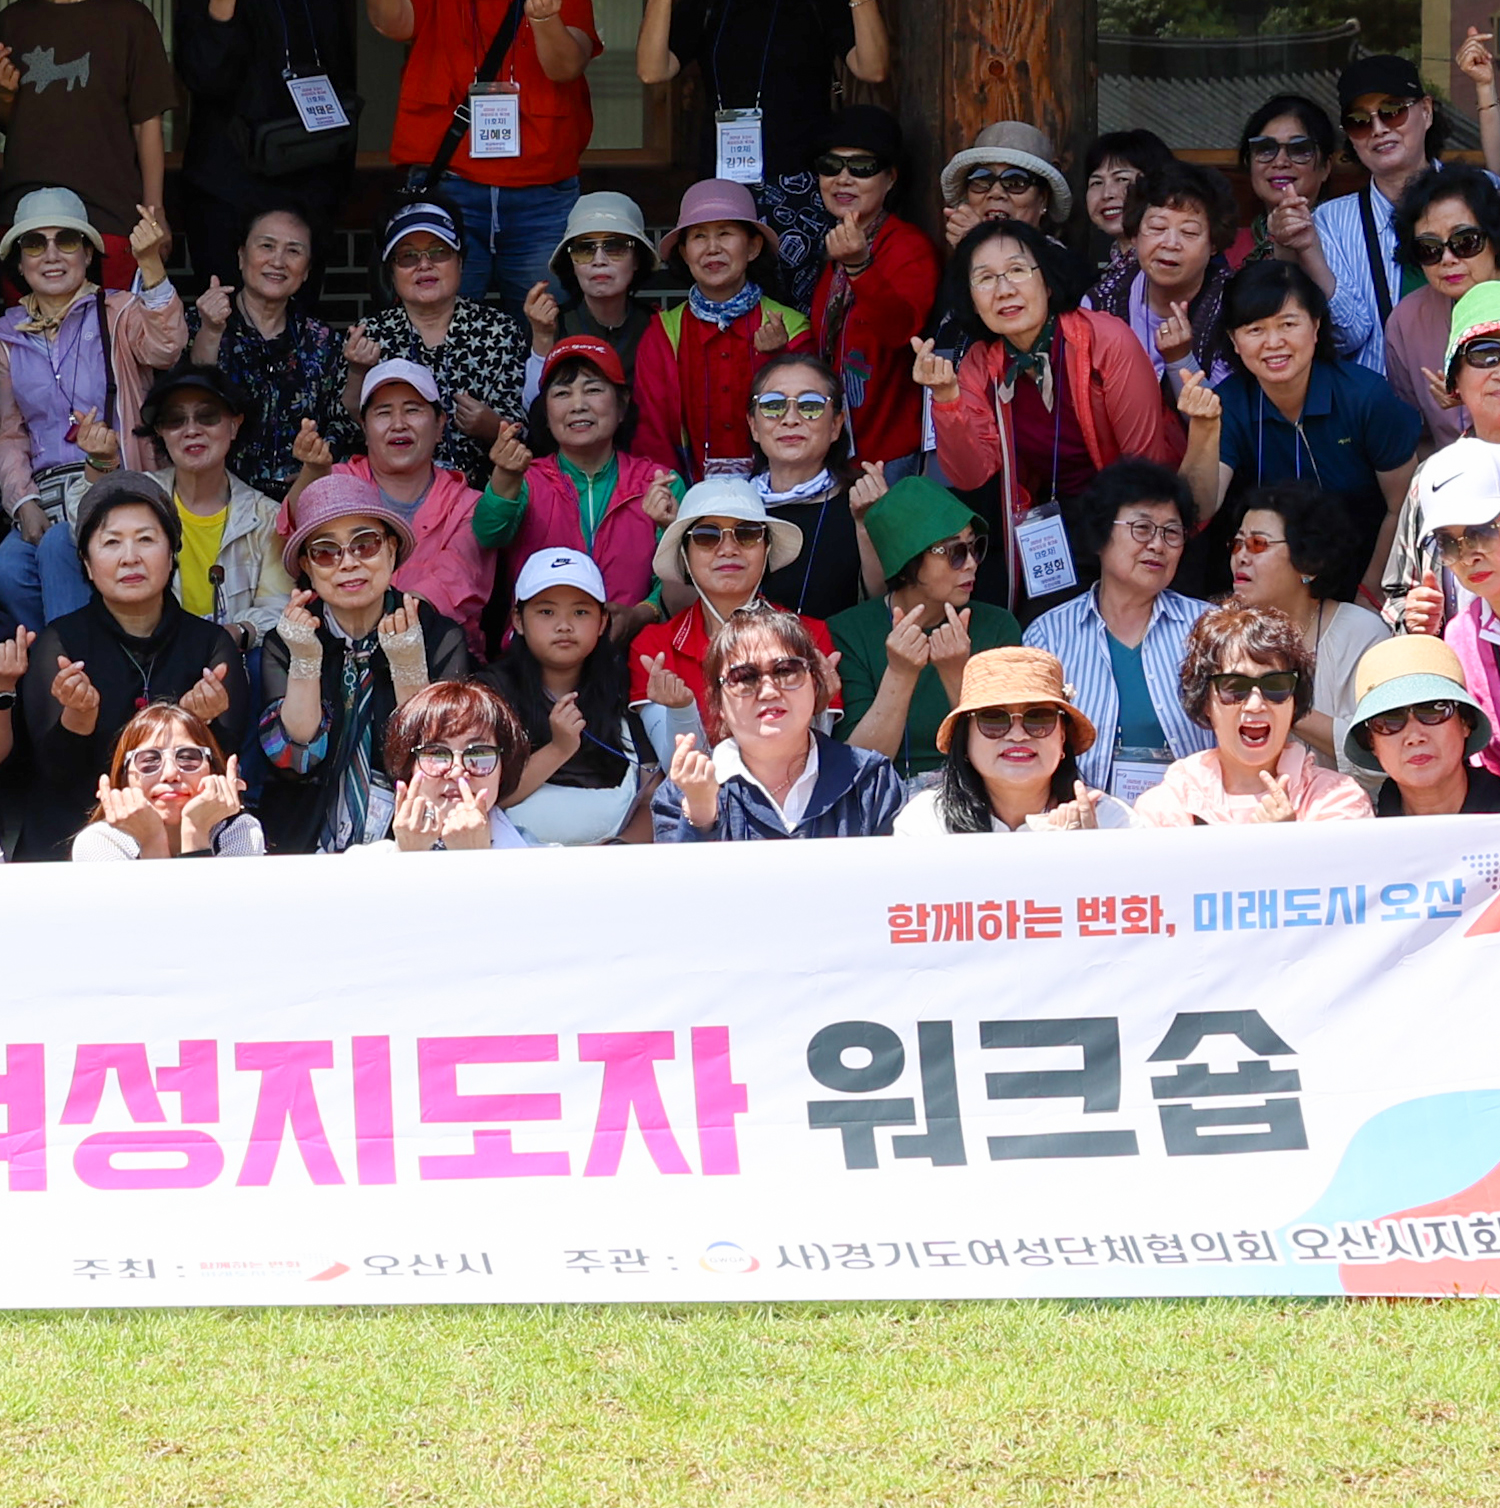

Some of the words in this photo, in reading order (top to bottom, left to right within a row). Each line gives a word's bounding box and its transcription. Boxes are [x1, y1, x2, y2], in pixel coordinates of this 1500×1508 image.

[887, 899, 1064, 945] 함께하는
[1076, 894, 1178, 939] 변화,
[1193, 884, 1367, 933] 미래도시
[1379, 878, 1468, 922] 오산
[805, 1008, 1311, 1171] 워크숍
[72, 1258, 157, 1280] 주최
[363, 1252, 494, 1277] 오산시
[562, 1247, 651, 1274] 주관
